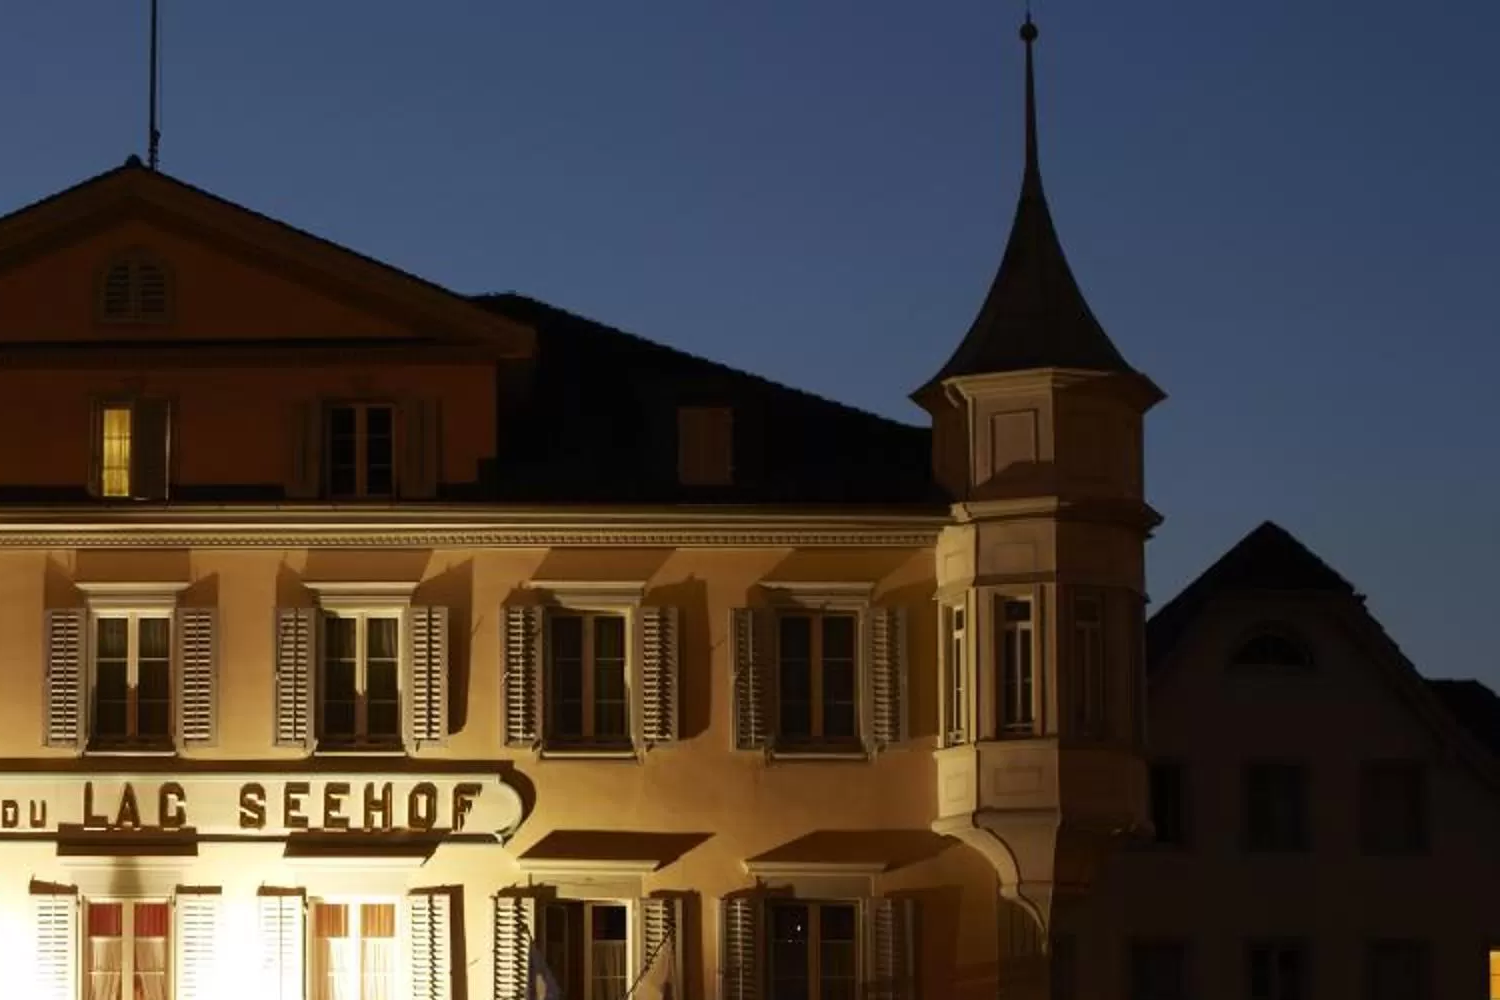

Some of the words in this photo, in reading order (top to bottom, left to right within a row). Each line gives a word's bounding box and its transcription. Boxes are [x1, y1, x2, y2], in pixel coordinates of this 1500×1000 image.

[2, 799, 47, 828] DU
[83, 781, 187, 830] LAC
[239, 781, 483, 831] SEEHOF
